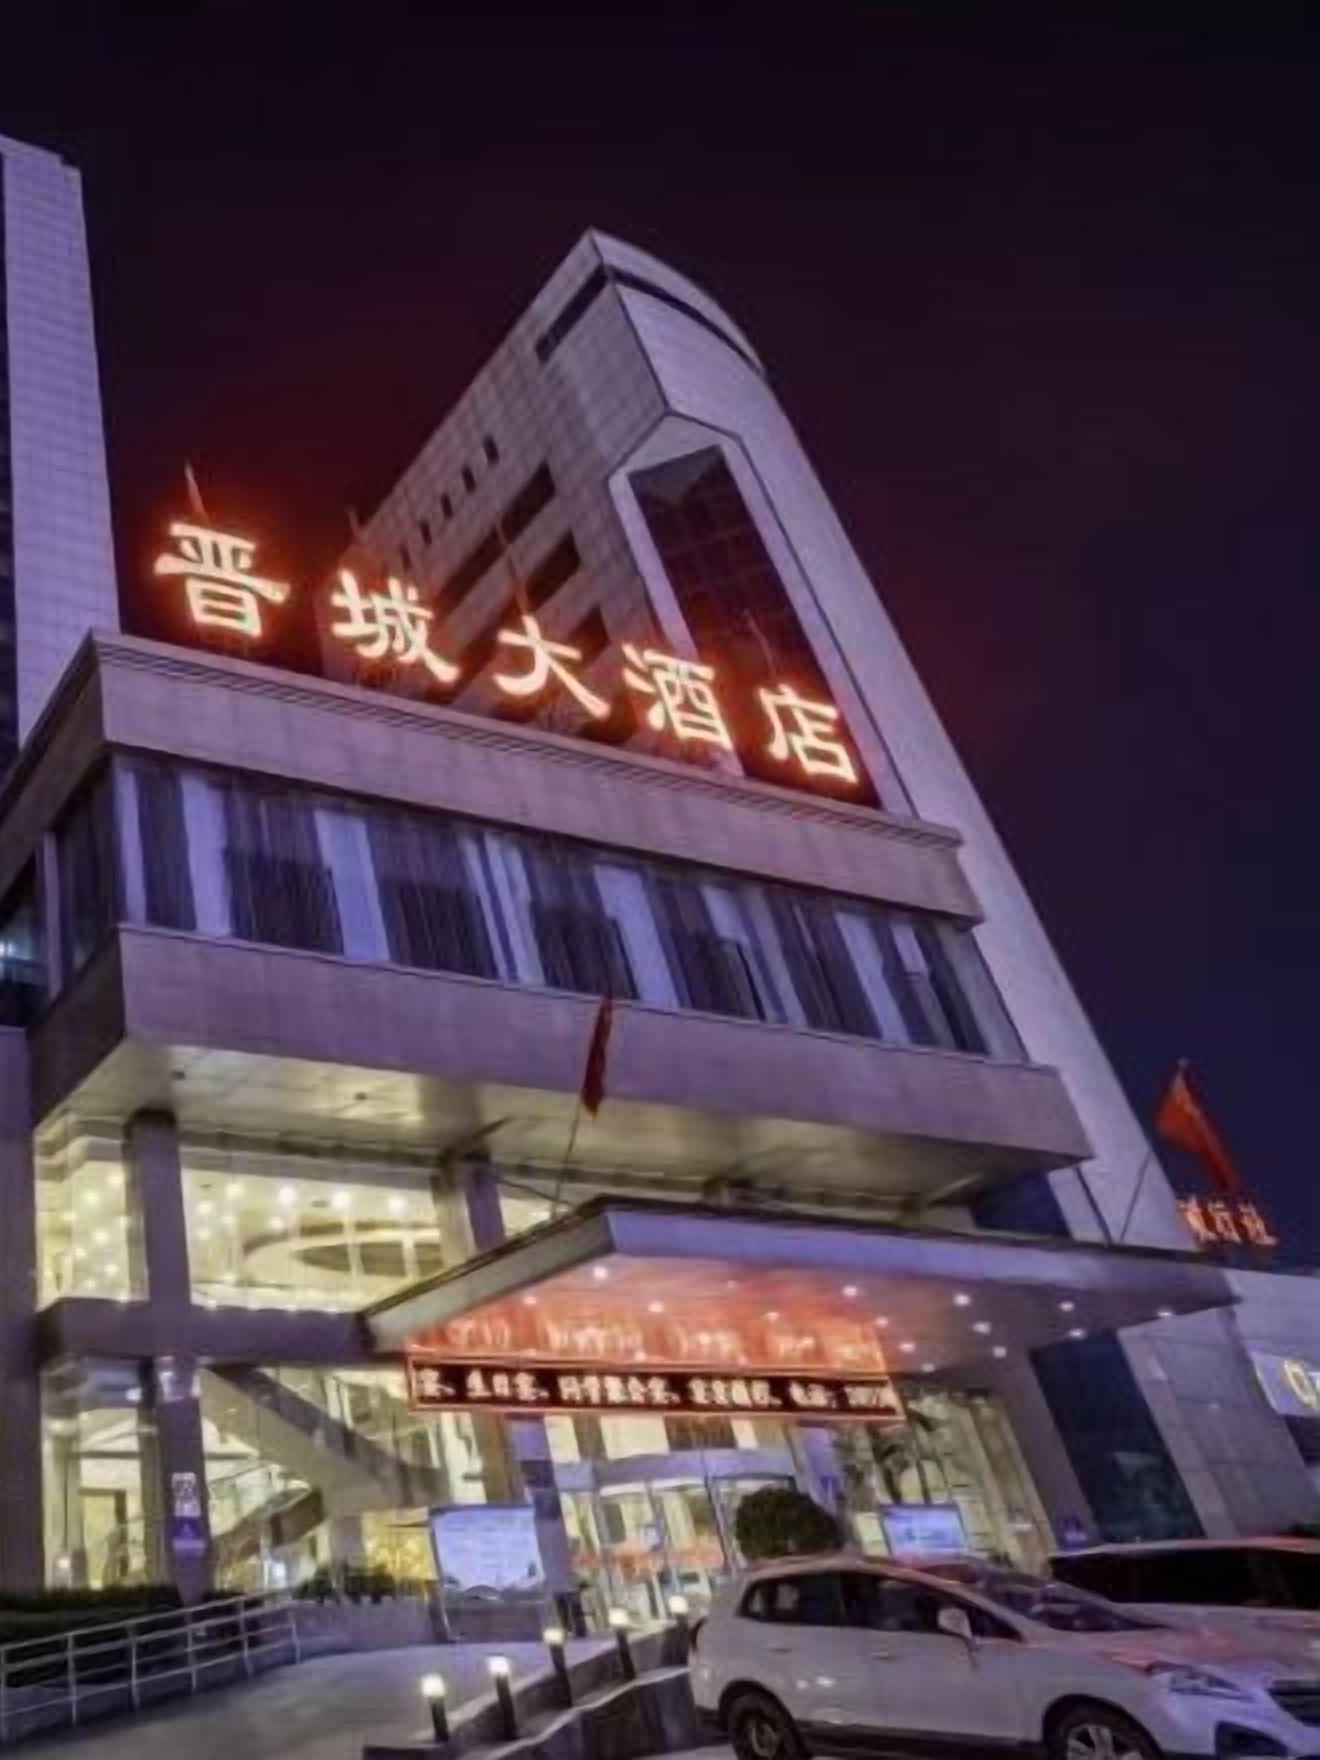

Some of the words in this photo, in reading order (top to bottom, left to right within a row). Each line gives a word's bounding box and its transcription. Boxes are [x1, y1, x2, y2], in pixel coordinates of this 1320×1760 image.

[154, 521, 858, 784] 晋城大酒店
